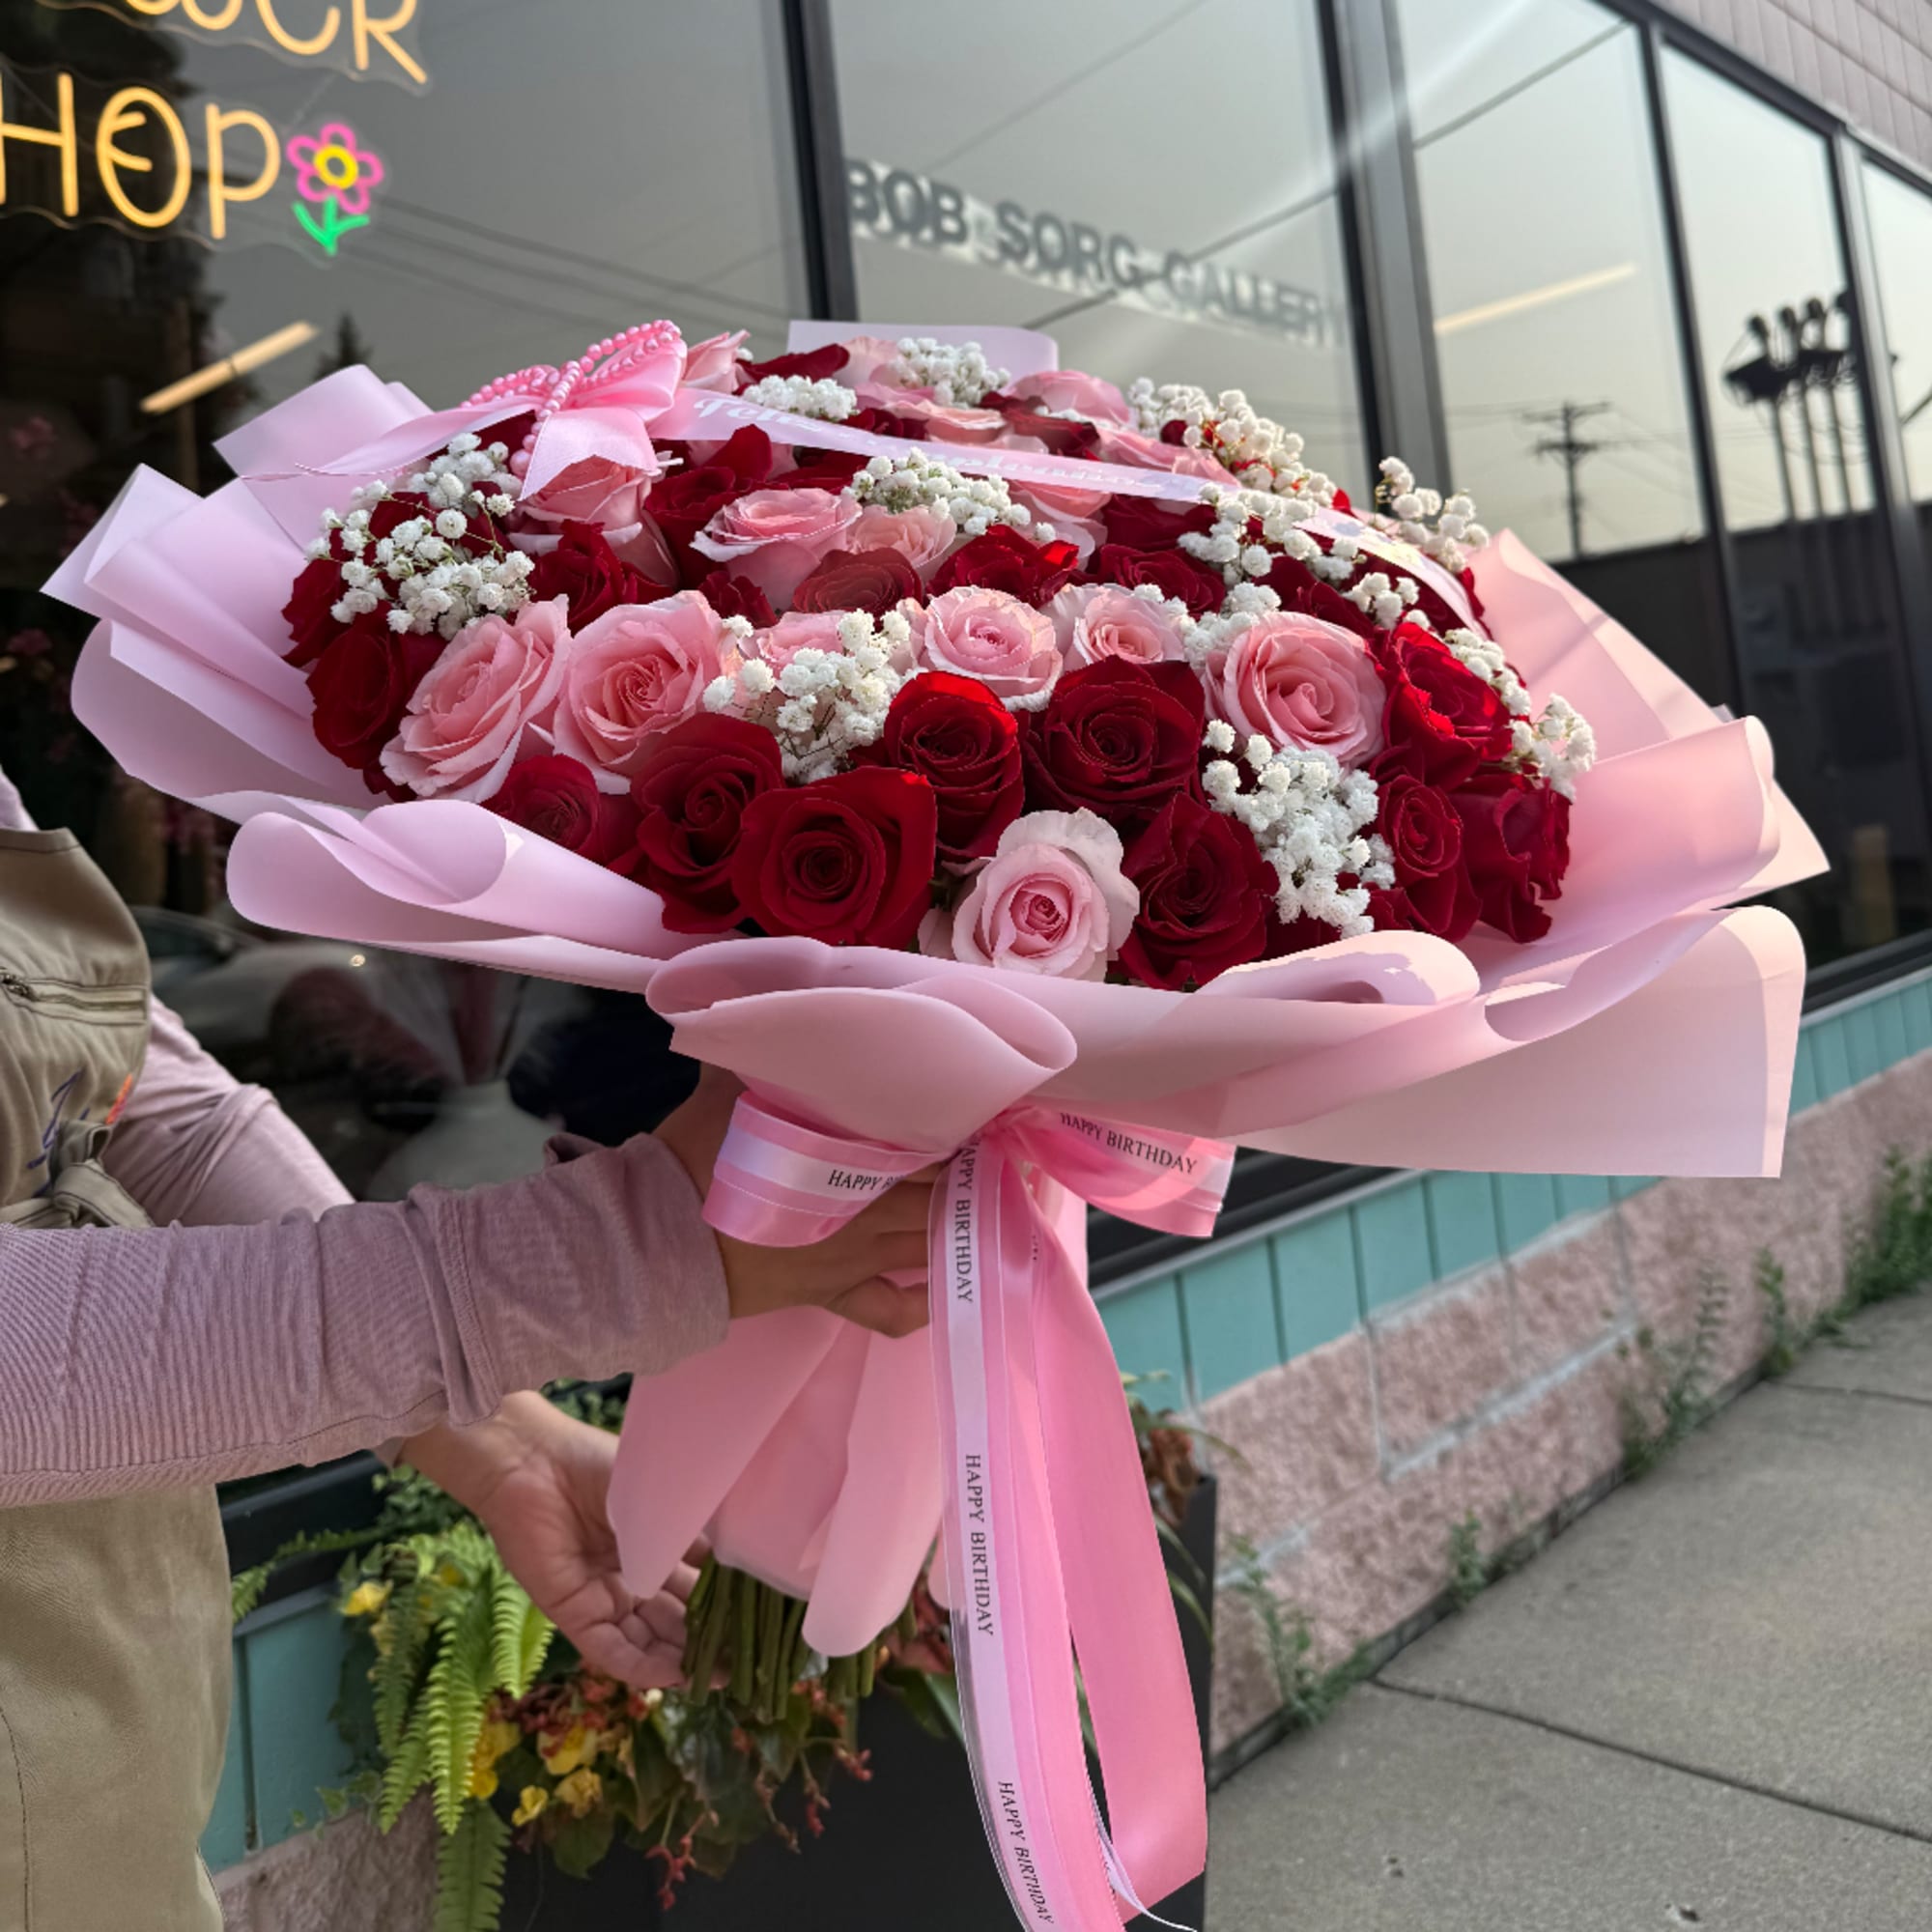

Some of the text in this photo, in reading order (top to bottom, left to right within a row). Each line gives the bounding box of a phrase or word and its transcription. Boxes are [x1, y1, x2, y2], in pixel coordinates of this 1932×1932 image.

[841, 158, 966, 245] BOB
[995, 200, 1144, 288] SORG
[828, 1169, 883, 1190] HAPPY
[1060, 1113, 1197, 1174] HAPPY BIRTHDAY
[954, 1200, 973, 1302] BIRTHDAY
[966, 1455, 993, 1635] HAPPY BIRTHDAY
[998, 1780, 1054, 1924] HAPPY BIRTHDAY
